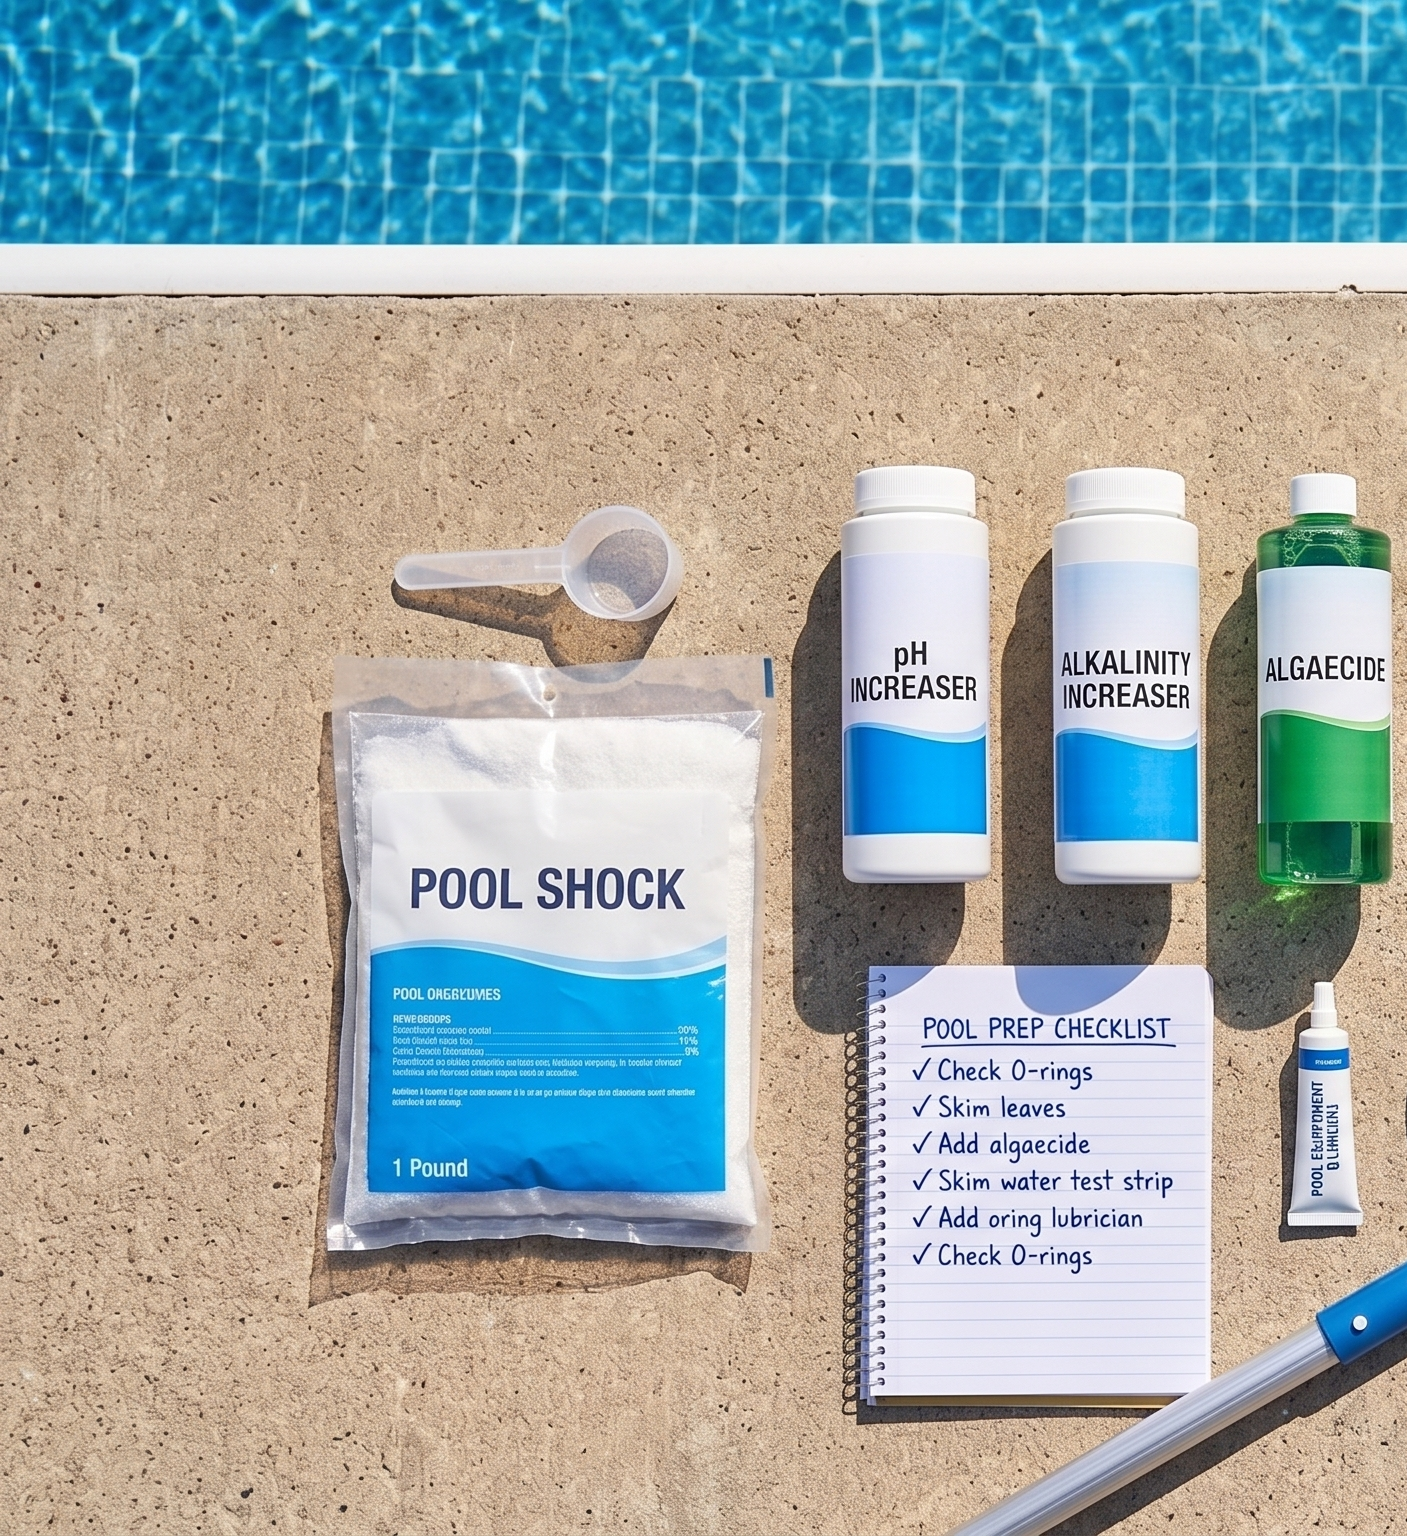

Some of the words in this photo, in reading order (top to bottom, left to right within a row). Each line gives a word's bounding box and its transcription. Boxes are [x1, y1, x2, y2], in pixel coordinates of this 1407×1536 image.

[894, 640, 927, 673] pH
[1060, 649, 1191, 677] ALKALINITY
[1265, 654, 1386, 683] ALGAECIDE
[850, 674, 977, 702] INCREASER
[1062, 683, 1190, 709] INCREASER
[411, 868, 523, 909] POOL
[537, 868, 685, 910] SHOCK
[393, 988, 424, 1000] POOL
[923, 1017, 977, 1039] POOL
[989, 1017, 1043, 1039] PREP
[1054, 1018, 1171, 1039] CHECKLIST
[938, 1058, 1001, 1081] Check
[1012, 1059, 1093, 1090] O-rings
[938, 1095, 990, 1118] Skim
[1001, 1095, 1066, 1118] leaves
[938, 1132, 979, 1154] Add
[989, 1132, 1091, 1163] algaecide
[392, 1159, 401, 1177] 1
[410, 1159, 468, 1178] Pound
[1311, 1164, 1324, 1197] POOL
[938, 1169, 990, 1191] Skim
[1000, 1172, 1062, 1191] water
[1070, 1169, 1113, 1191] test
[1123, 1169, 1174, 1199] strip
[938, 1206, 979, 1228] Add
[988, 1209, 1042, 1238] oring
[1052, 1206, 1143, 1228] lubrician
[938, 1244, 1001, 1266] Check
[1012, 1244, 1093, 1275] O-rings
